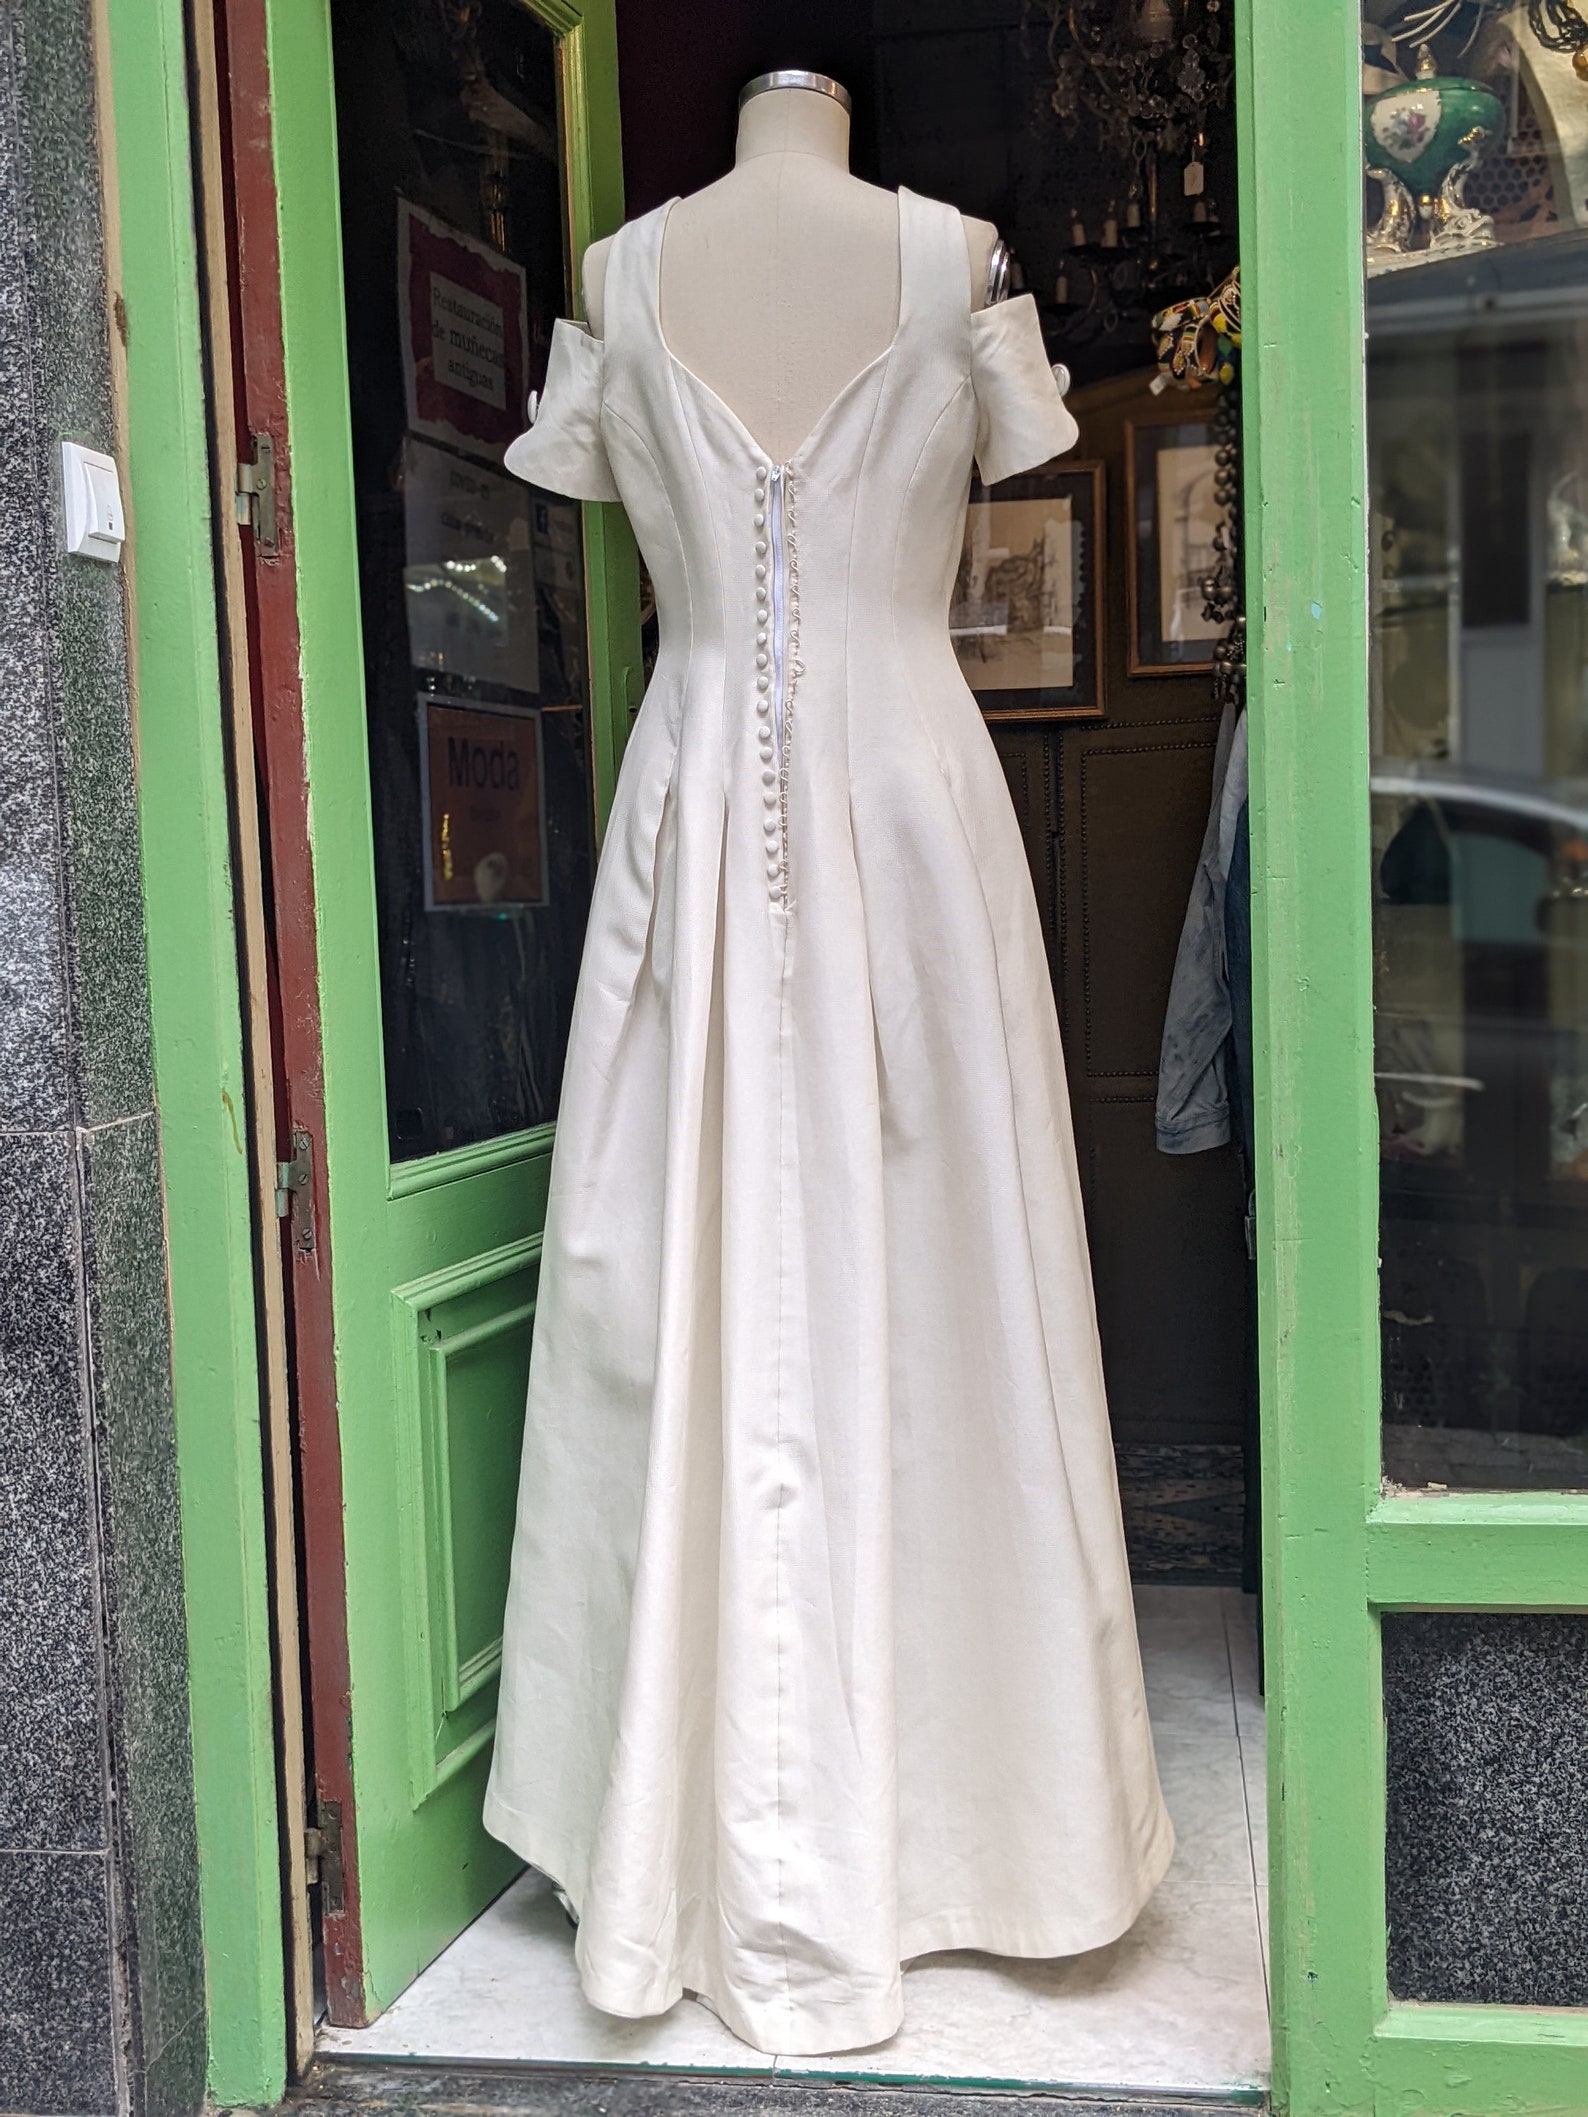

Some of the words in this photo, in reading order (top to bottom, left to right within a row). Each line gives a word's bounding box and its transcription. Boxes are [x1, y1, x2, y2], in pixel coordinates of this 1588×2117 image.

[433, 287, 503, 338] Restauración
[433, 319, 445, 341] de
[448, 359, 493, 390] antiguas
[448, 736, 520, 791] Moda
